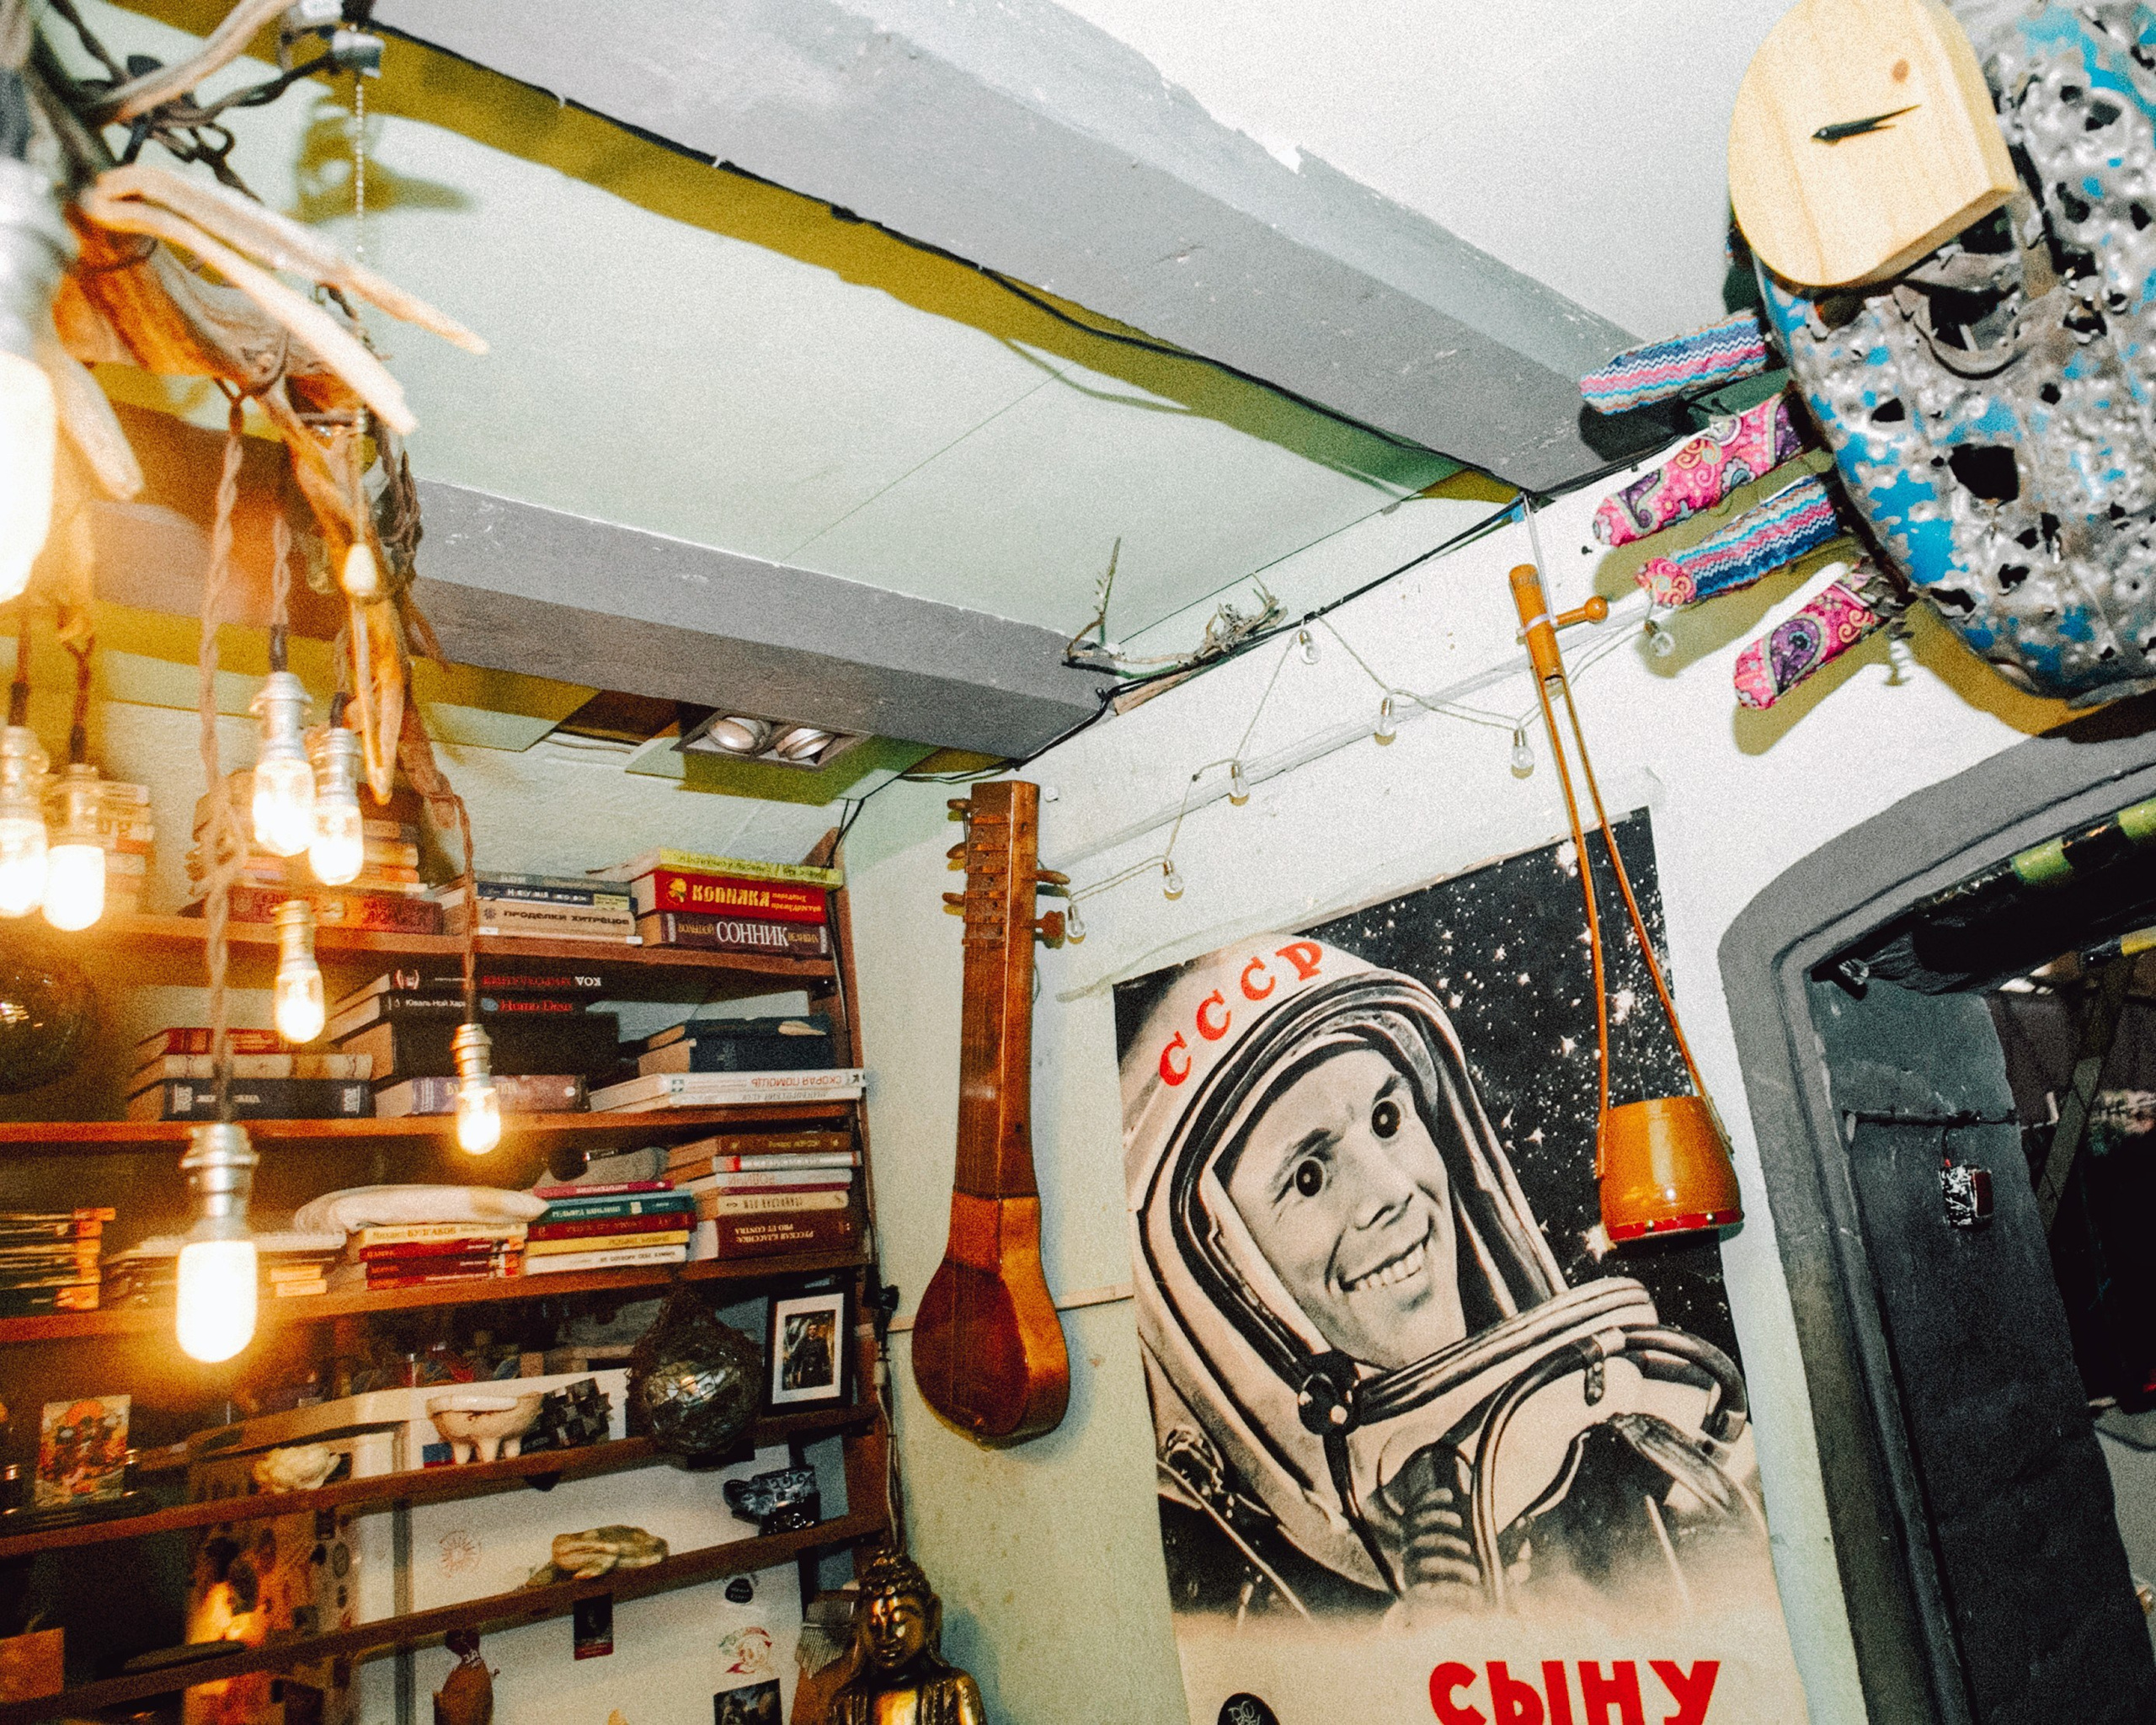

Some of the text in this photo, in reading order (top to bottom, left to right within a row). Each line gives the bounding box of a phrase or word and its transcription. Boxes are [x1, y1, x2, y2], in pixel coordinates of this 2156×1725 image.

[716, 921, 789, 947] СОННИК
[575, 976, 602, 986] КОД
[1159, 941, 1323, 1087] СССР
[750, 1076, 800, 1088] ПОМОЩЬ
[802, 1076, 842, 1087] СКОРАЯ
[1429, 1660, 1721, 1725] СЫНУ
